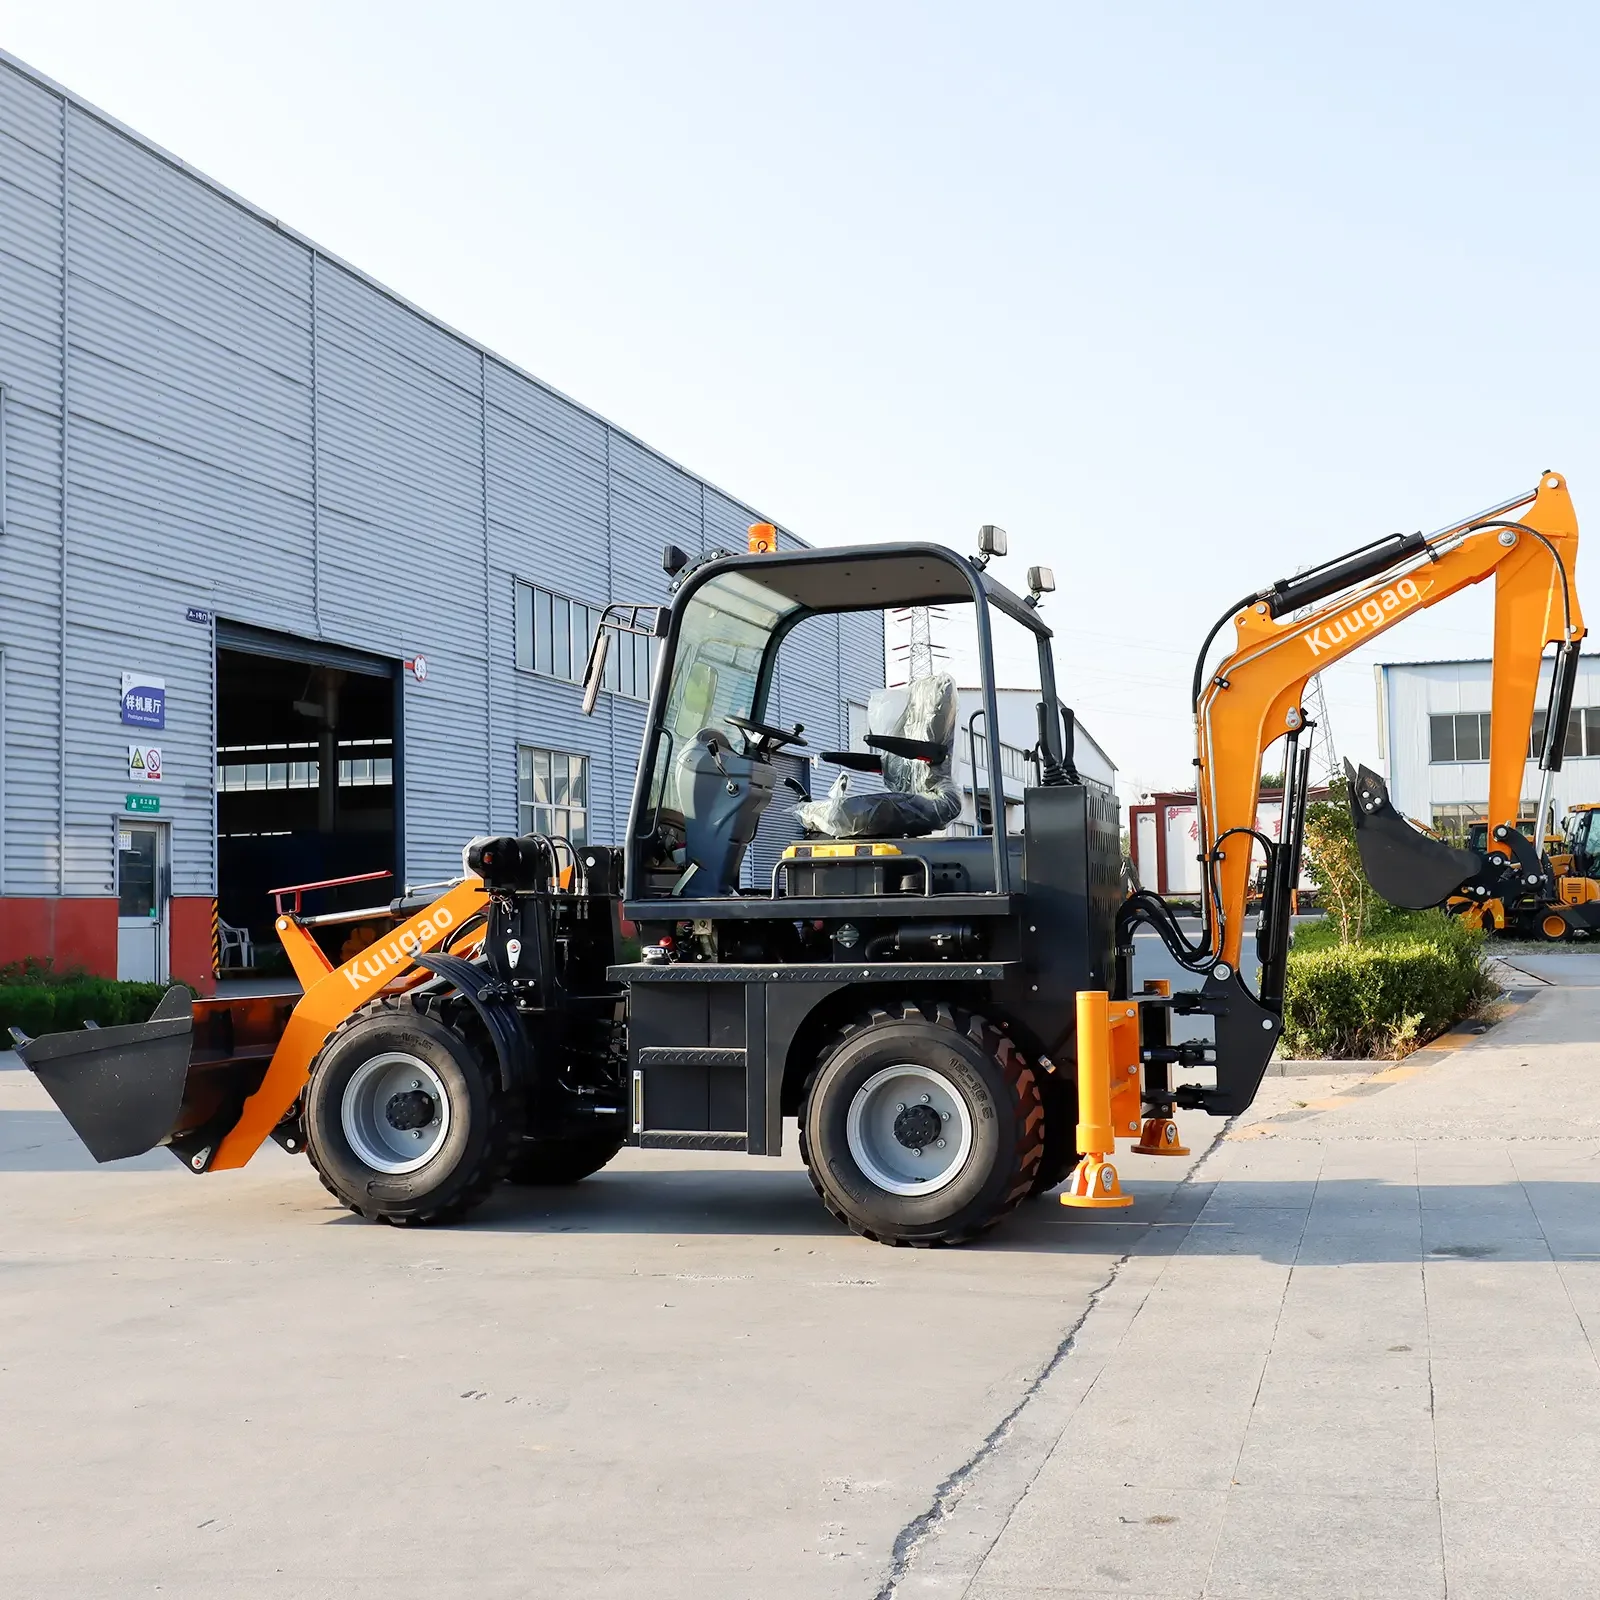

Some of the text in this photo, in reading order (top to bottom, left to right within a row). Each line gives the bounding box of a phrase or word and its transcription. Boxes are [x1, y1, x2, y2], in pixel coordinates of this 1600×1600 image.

[1303, 578, 1417, 656] Kuugao
[126, 694, 162, 714] 样机展厅
[342, 907, 453, 991] Kuugao
[948, 1057, 994, 1119] 12-16.5
